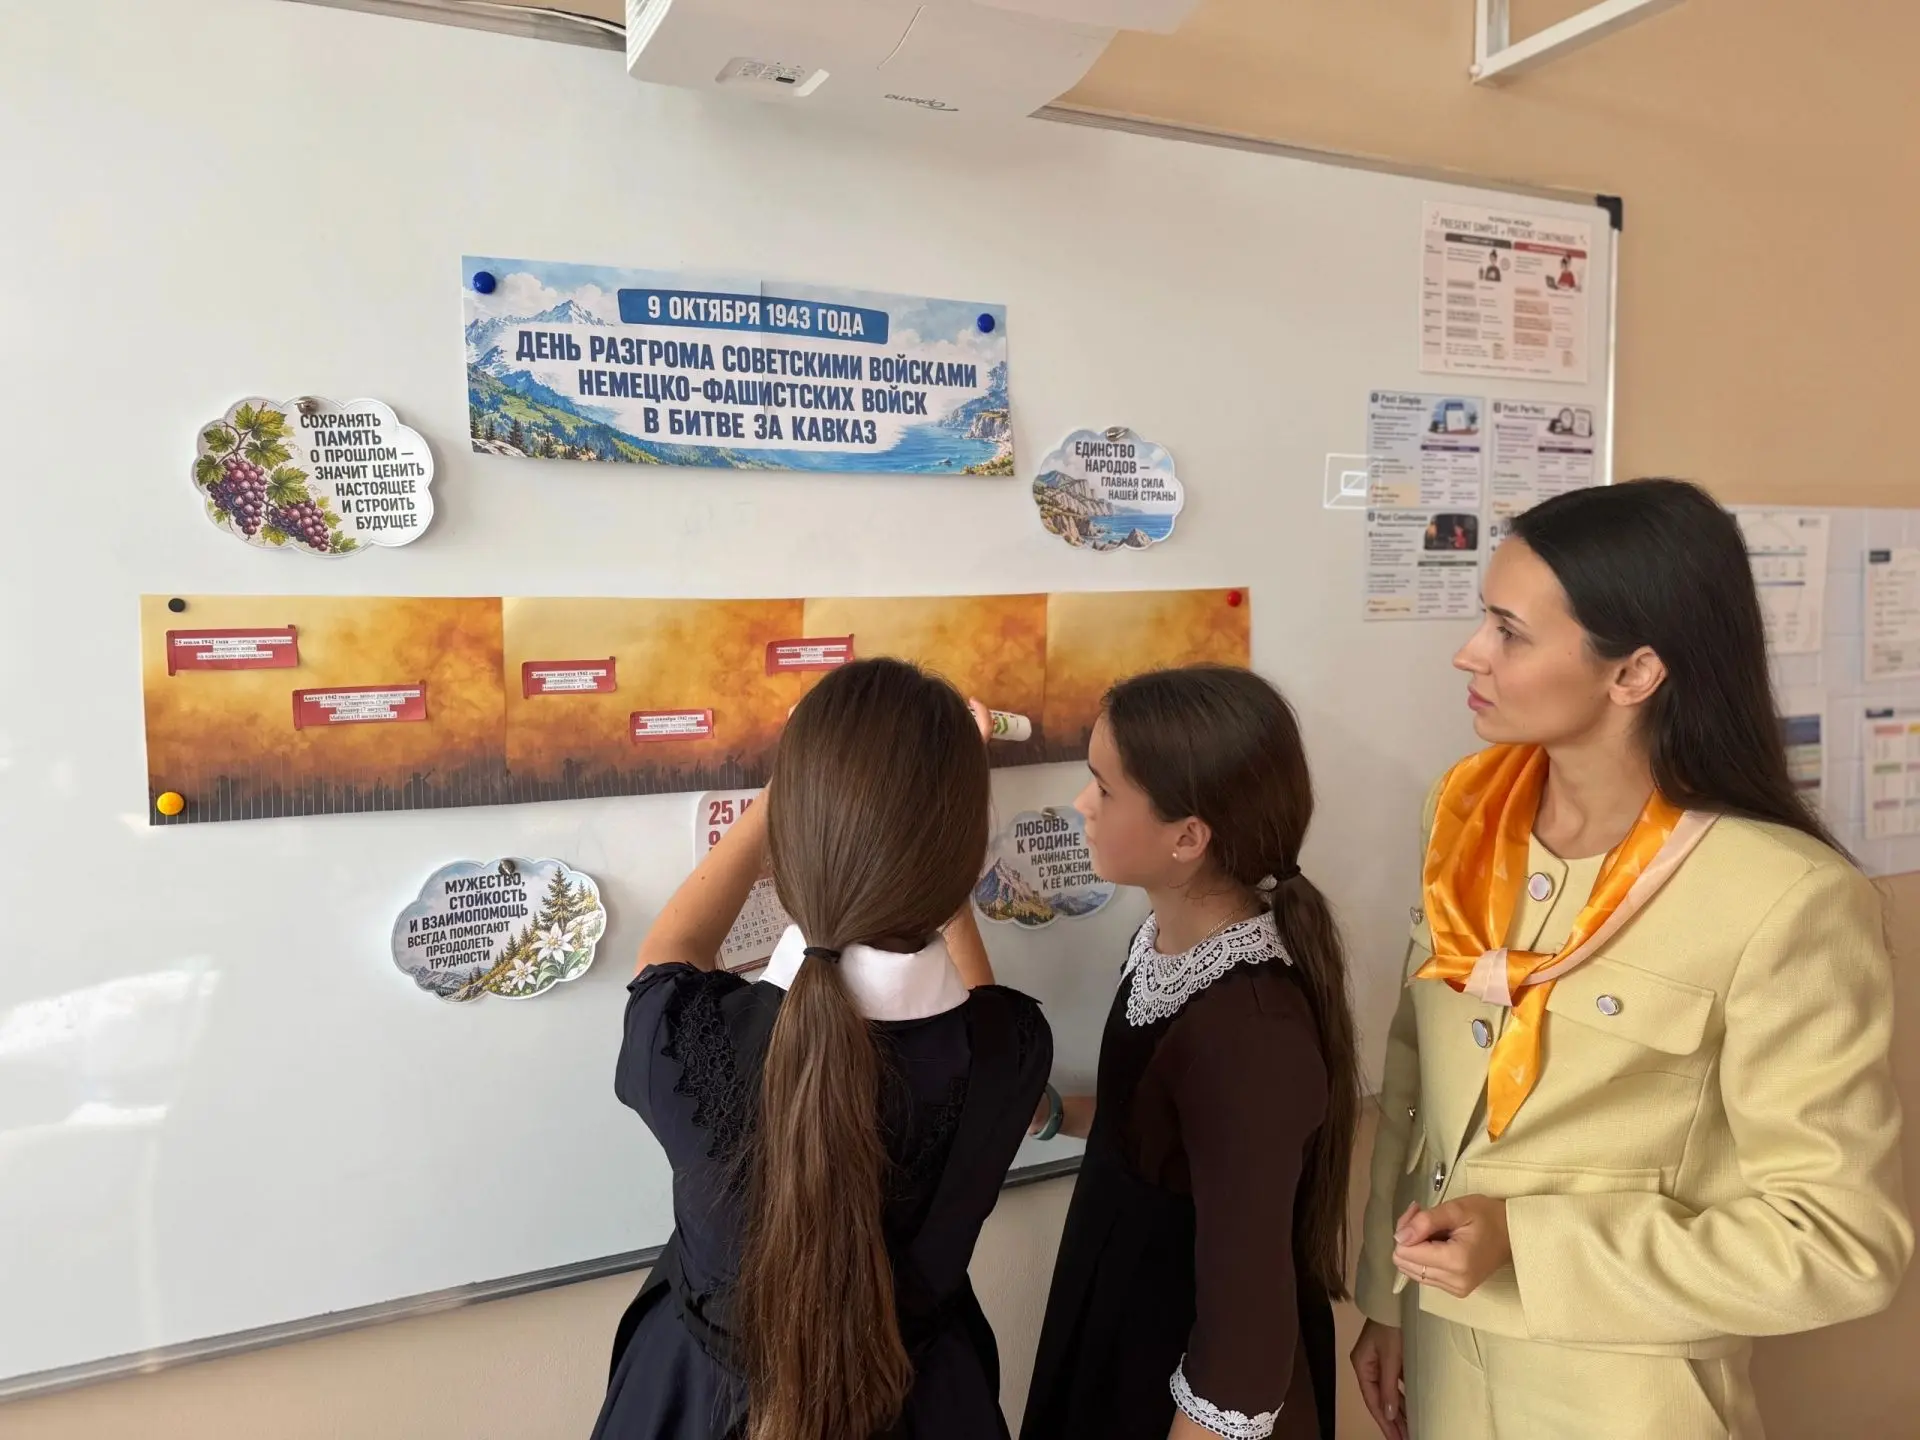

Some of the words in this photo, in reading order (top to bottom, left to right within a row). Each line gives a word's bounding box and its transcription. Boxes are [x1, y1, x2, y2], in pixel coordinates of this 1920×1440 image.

[1440, 217, 1472, 230] PRESENT
[1473, 221, 1499, 235] SIMPLE
[1507, 226, 1536, 239] PRESENT
[647, 295, 658, 319] 9
[669, 296, 761, 326] ОКТЯБРЯ
[766, 302, 811, 330] 1943
[817, 308, 865, 337] ГОДА
[515, 330, 582, 362] ДЕНЬ
[589, 334, 715, 371] РАЗГРОМА
[722, 344, 863, 381] СОВЕТСКИМИ
[869, 353, 978, 388] ВОЙСКАМИ
[578, 369, 856, 412] НЕМЕЦКО-ФАШИСТСКИХ
[861, 385, 928, 416] ВОЙСК
[300, 413, 382, 429] СОХРАНЯТЬ
[643, 407, 660, 434] В
[668, 408, 746, 439] БИТВЕ
[753, 413, 784, 440] ЗА
[791, 415, 877, 444] КАВКАЗ
[314, 429, 382, 447] ПАМЯТЬ
[310, 449, 320, 463] О
[324, 447, 398, 463] ПРОШЛОМ
[1075, 441, 1135, 458] ЕДИНСТВО
[315, 464, 368, 481] ЗНАЧИТ
[372, 462, 425, 480] ЦЕНИТЬ
[1085, 459, 1137, 475] НАРОДОВ
[335, 480, 416, 497] НАСТОЯЩЕЕ
[1101, 476, 1139, 489] ГЛАВНАЯ
[1141, 478, 1165, 489] СИЛА
[1108, 488, 1139, 501] НАШЕЙ
[1140, 490, 1177, 501] СТРАНЫ
[342, 500, 352, 513] И
[355, 497, 415, 513] СТРОИТЬ
[355, 514, 418, 531] БУДУЩЕЕ
[709, 800, 734, 825] 25
[1014, 818, 1069, 838] ЛЮБОВЬ
[1017, 839, 1025, 854] К
[1028, 832, 1081, 853] РОДИНЕ
[1031, 848, 1090, 866] НАЧИНАЕТСЯ
[1038, 866, 1045, 878] С
[1046, 861, 1094, 877] УВАЖЕНИ
[445, 872, 526, 895] МУЖЕСТВО,
[1042, 879, 1049, 890] К
[1063, 872, 1108, 888] ИСТОРИ
[449, 889, 528, 911] СТОЙКОСТЬ
[409, 919, 418, 933] И
[422, 904, 529, 931] ВЗАИМОПОМОЩЬ
[407, 931, 448, 948] ВСЕГДА
[449, 920, 511, 940] ПОМОГАЮТ
[425, 936, 494, 958] ПРЕОДОЛЕТЬ
[429, 950, 491, 970] ТРУДНОСТИ
